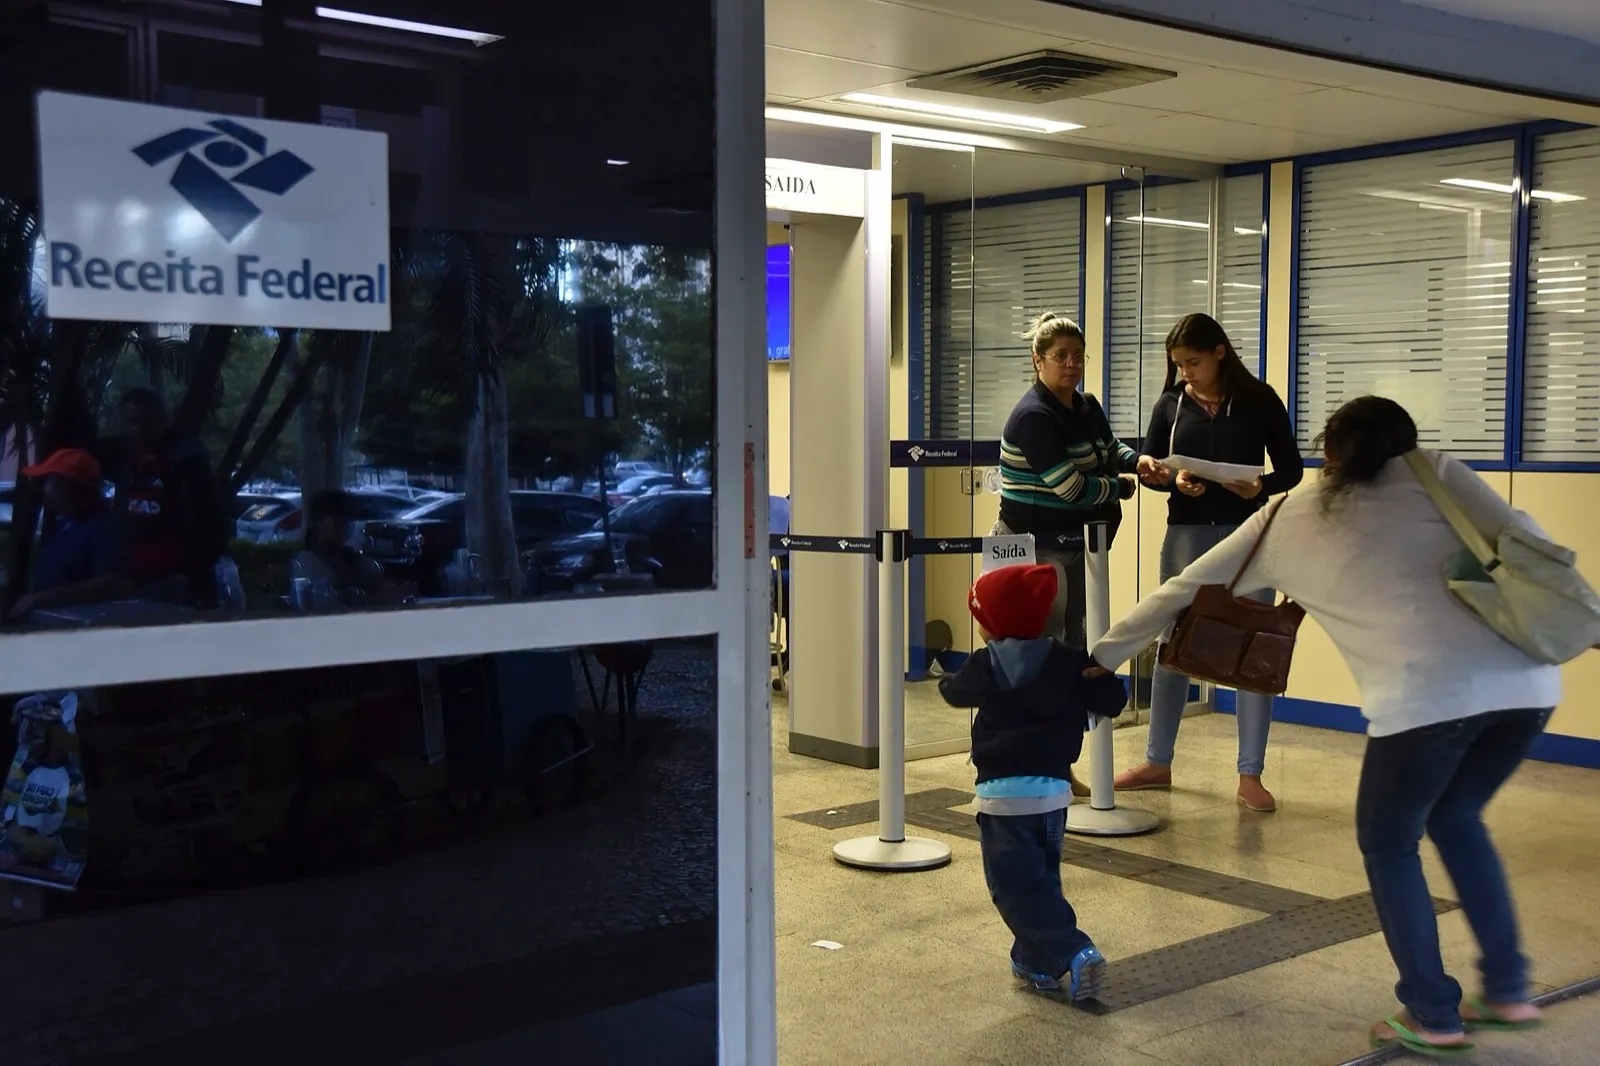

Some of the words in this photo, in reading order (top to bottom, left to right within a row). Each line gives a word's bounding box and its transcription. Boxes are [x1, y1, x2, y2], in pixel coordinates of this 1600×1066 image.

[50, 240, 225, 297] Receita
[236, 254, 387, 304] Federal
[992, 543, 1027, 560] Saída
